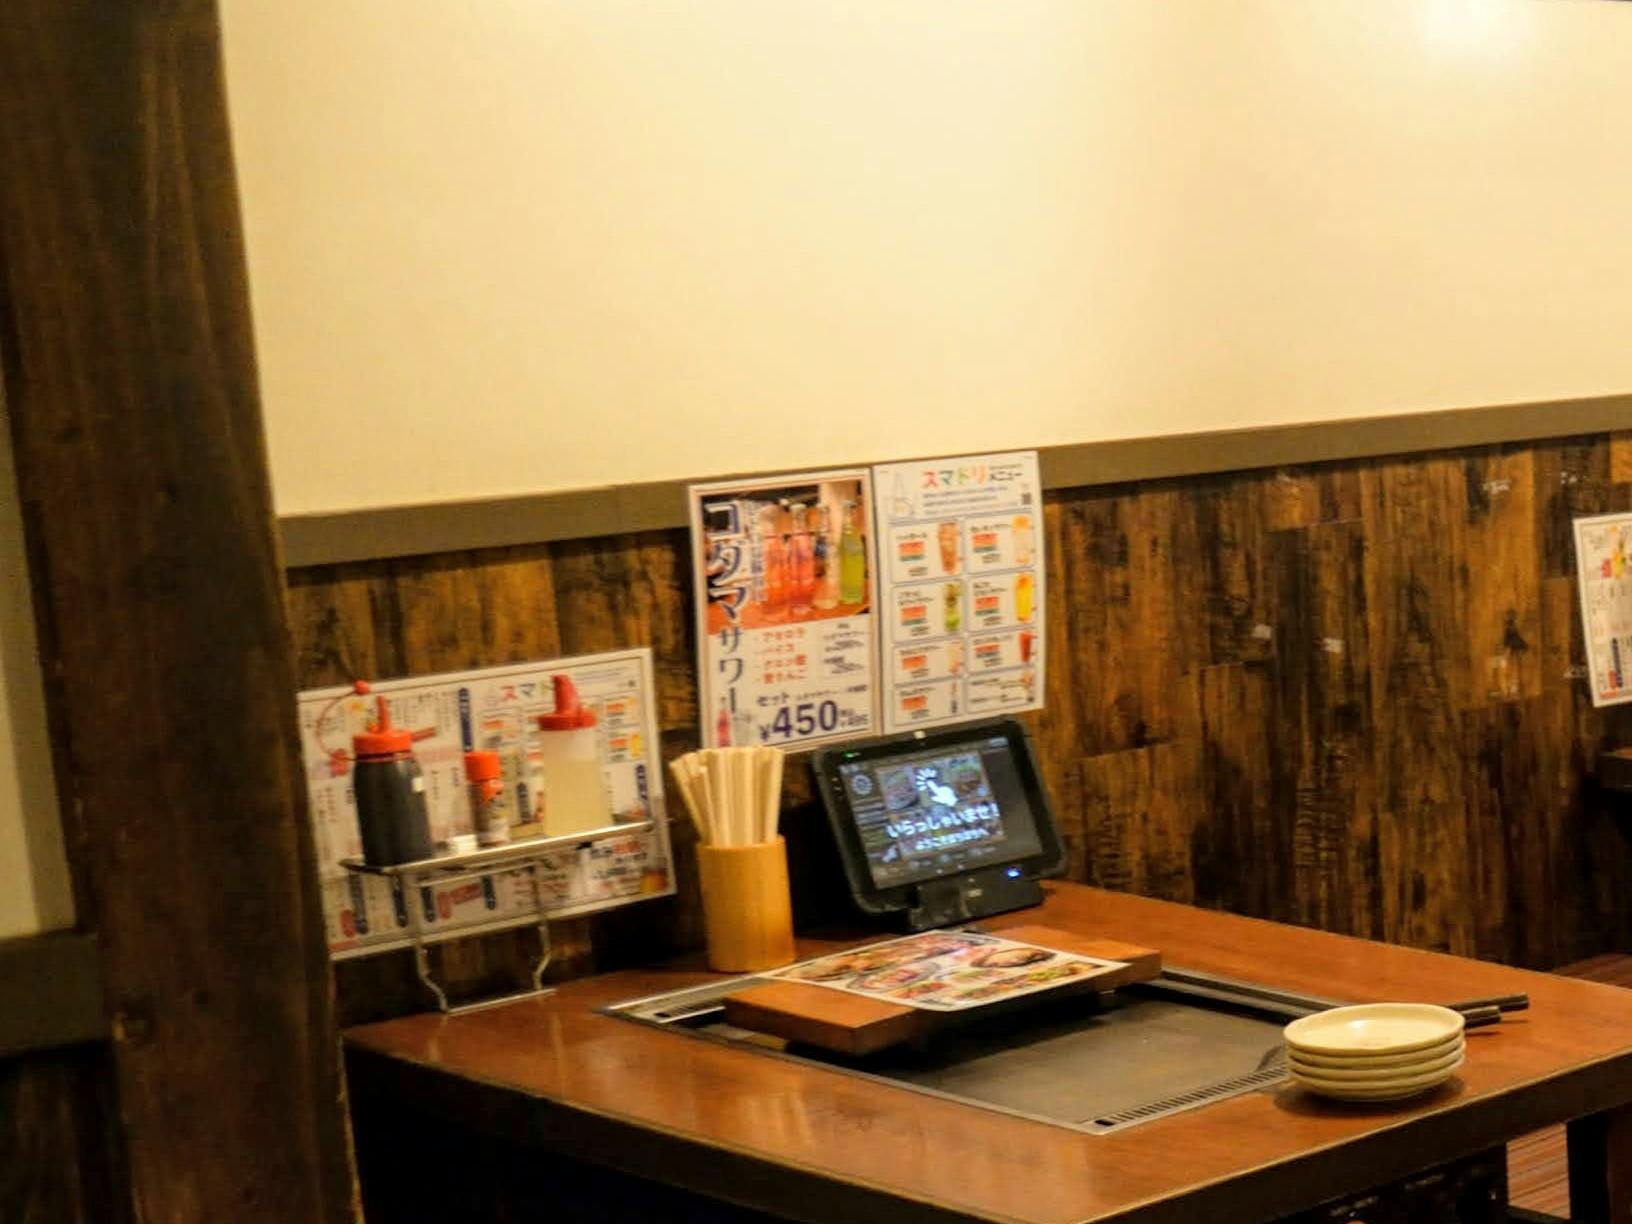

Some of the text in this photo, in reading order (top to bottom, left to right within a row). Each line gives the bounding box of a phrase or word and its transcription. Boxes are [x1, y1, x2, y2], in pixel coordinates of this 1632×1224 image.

[704, 501, 746, 714] コダマサワー
[759, 700, 838, 740] ¥450
